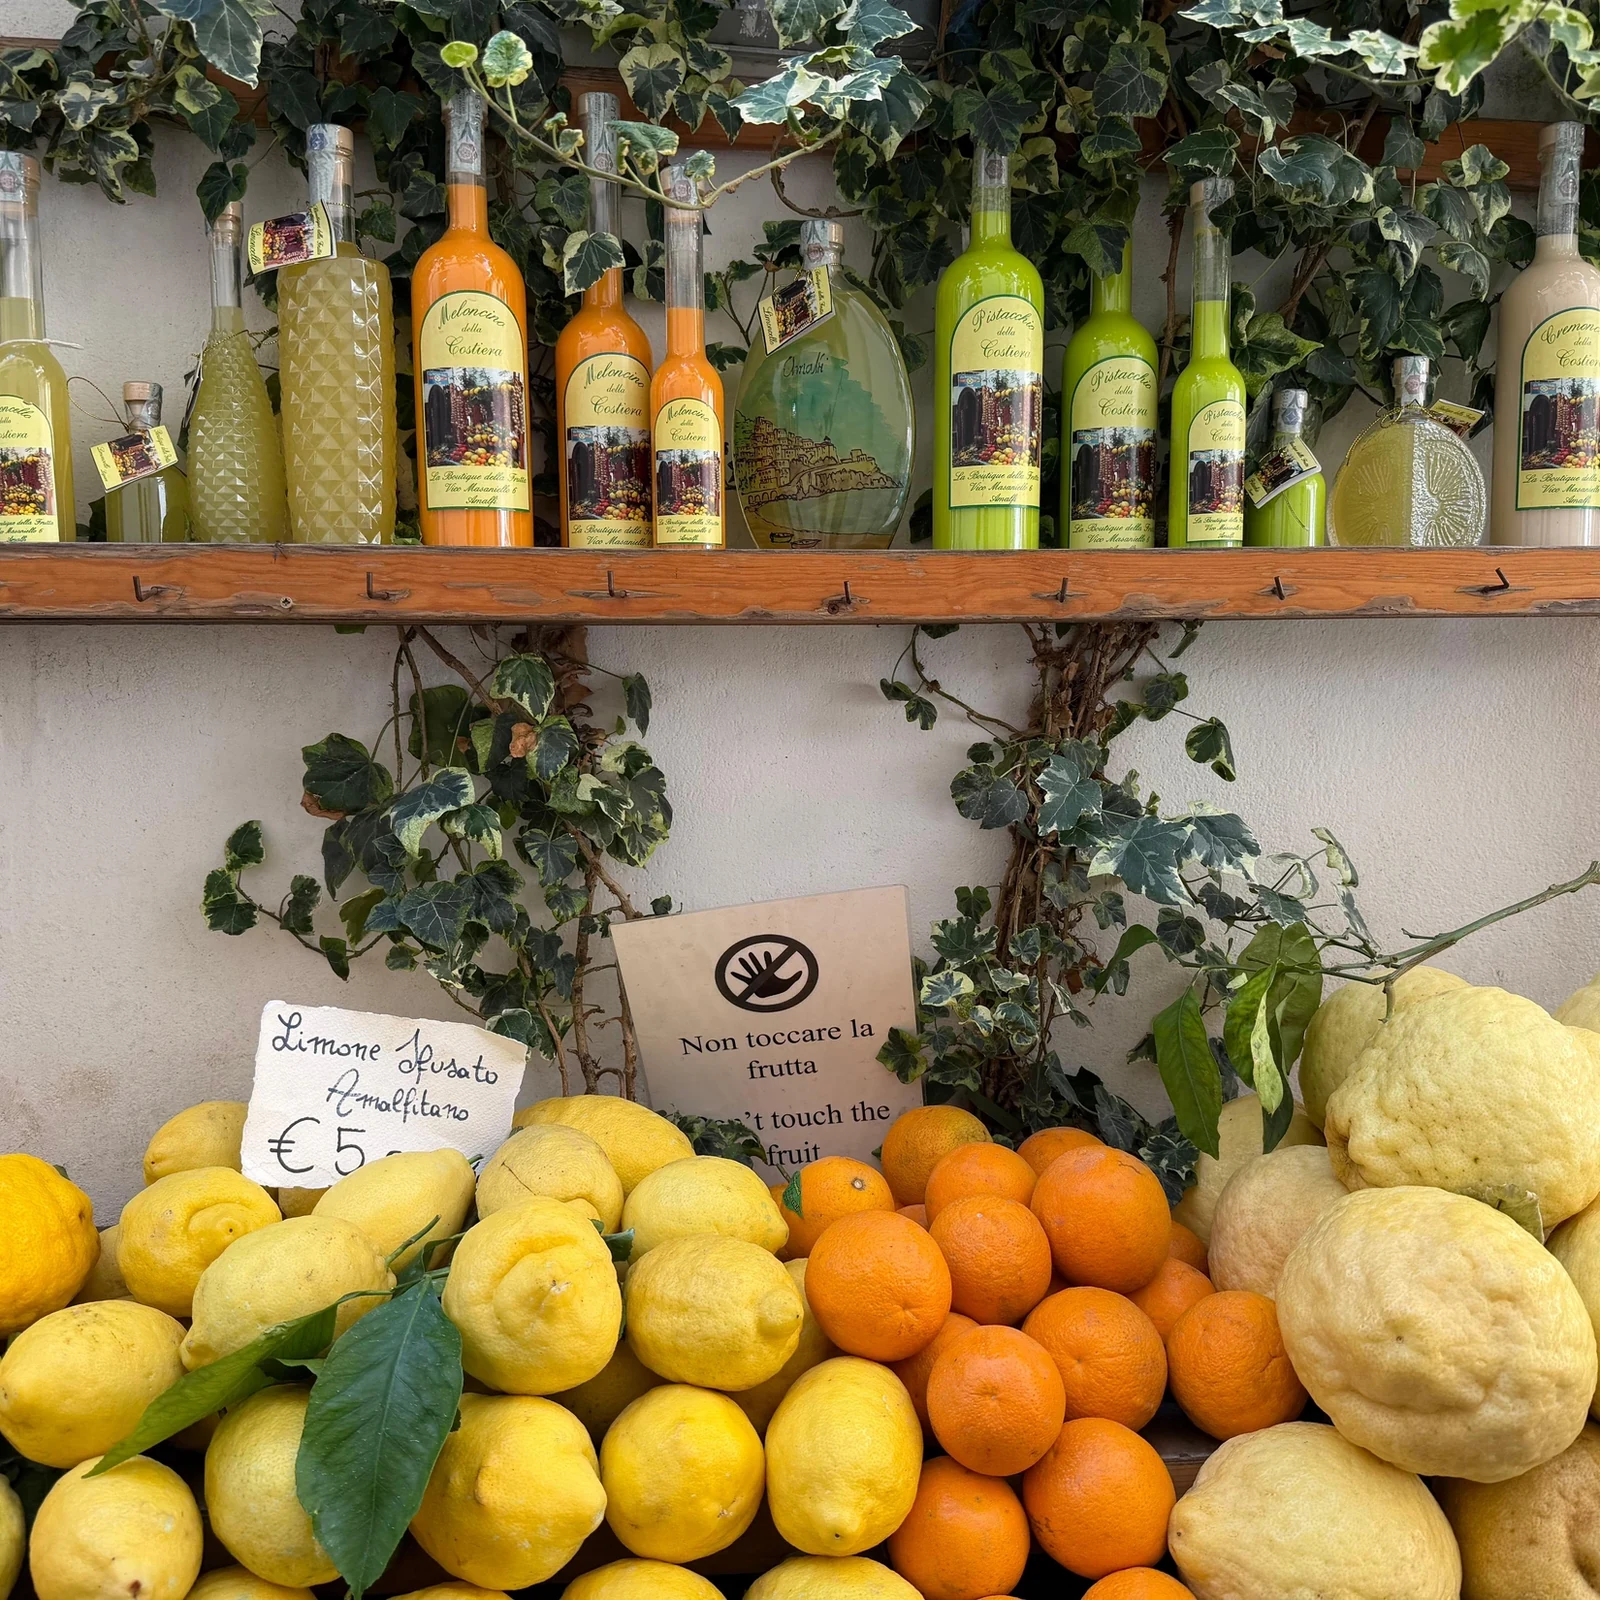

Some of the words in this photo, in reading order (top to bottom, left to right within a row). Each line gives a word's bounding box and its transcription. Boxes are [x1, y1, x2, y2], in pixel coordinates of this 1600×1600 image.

[250, 227, 262, 266] Limoncello
[438, 300, 505, 330] Meloncino
[972, 308, 1035, 333] Pistacchio
[461, 323, 482, 333] della
[763, 306, 778, 346] Limoncello
[996, 326, 1016, 336] della
[445, 335, 503, 356] Costiera
[980, 339, 1031, 358] Costiera
[1573, 337, 1592, 345] della
[1556, 348, 1600, 367] Costier
[584, 362, 645, 389] Meloncino
[1090, 369, 1152, 392] Pistacchio
[606, 383, 626, 394] della
[1114, 385, 1133, 395] della
[590, 395, 643, 416] Costiera
[666, 404, 709, 424] Meloncino
[1098, 398, 1148, 417] Costiera
[670, 428, 707, 441] Costiera
[430, 471, 440, 481] La
[442, 471, 482, 482] Boutique
[484, 472, 504, 481] della
[953, 471, 965, 481] La
[967, 471, 1005, 481] Boutique
[1006, 471, 1024, 480] della
[1522, 473, 1538, 483] La
[1540, 473, 1580, 484] Boutique
[445, 483, 461, 493] Vico
[464, 483, 510, 494] Masaniello
[969, 482, 987, 492] Vico
[1542, 484, 1560, 493] Vico
[466, 495, 498, 507] Amalfi
[571, 525, 582, 534] La
[584, 524, 621, 535] Boutique
[624, 526, 641, 534] della
[1072, 523, 1084, 533] La
[1085, 523, 1124, 533] Boutique
[1125, 523, 1142, 531] della
[586, 536, 604, 545] Vico
[605, 536, 646, 546] Masaniello
[1087, 534, 1104, 543] Vico
[679, 1035, 737, 1056] Non
[747, 1025, 842, 1048] toccare
[850, 1019, 875, 1038] la
[272, 1012, 382, 1061] Limone
[396, 1028, 499, 1084] Sfusato
[746, 1059, 818, 1080] frutta
[326, 1068, 470, 1123] Amalfitano
[771, 1104, 842, 1130] touch
[851, 1101, 891, 1122] the
[267, 1117, 321, 1174] €
[766, 1141, 820, 1166] fruit
